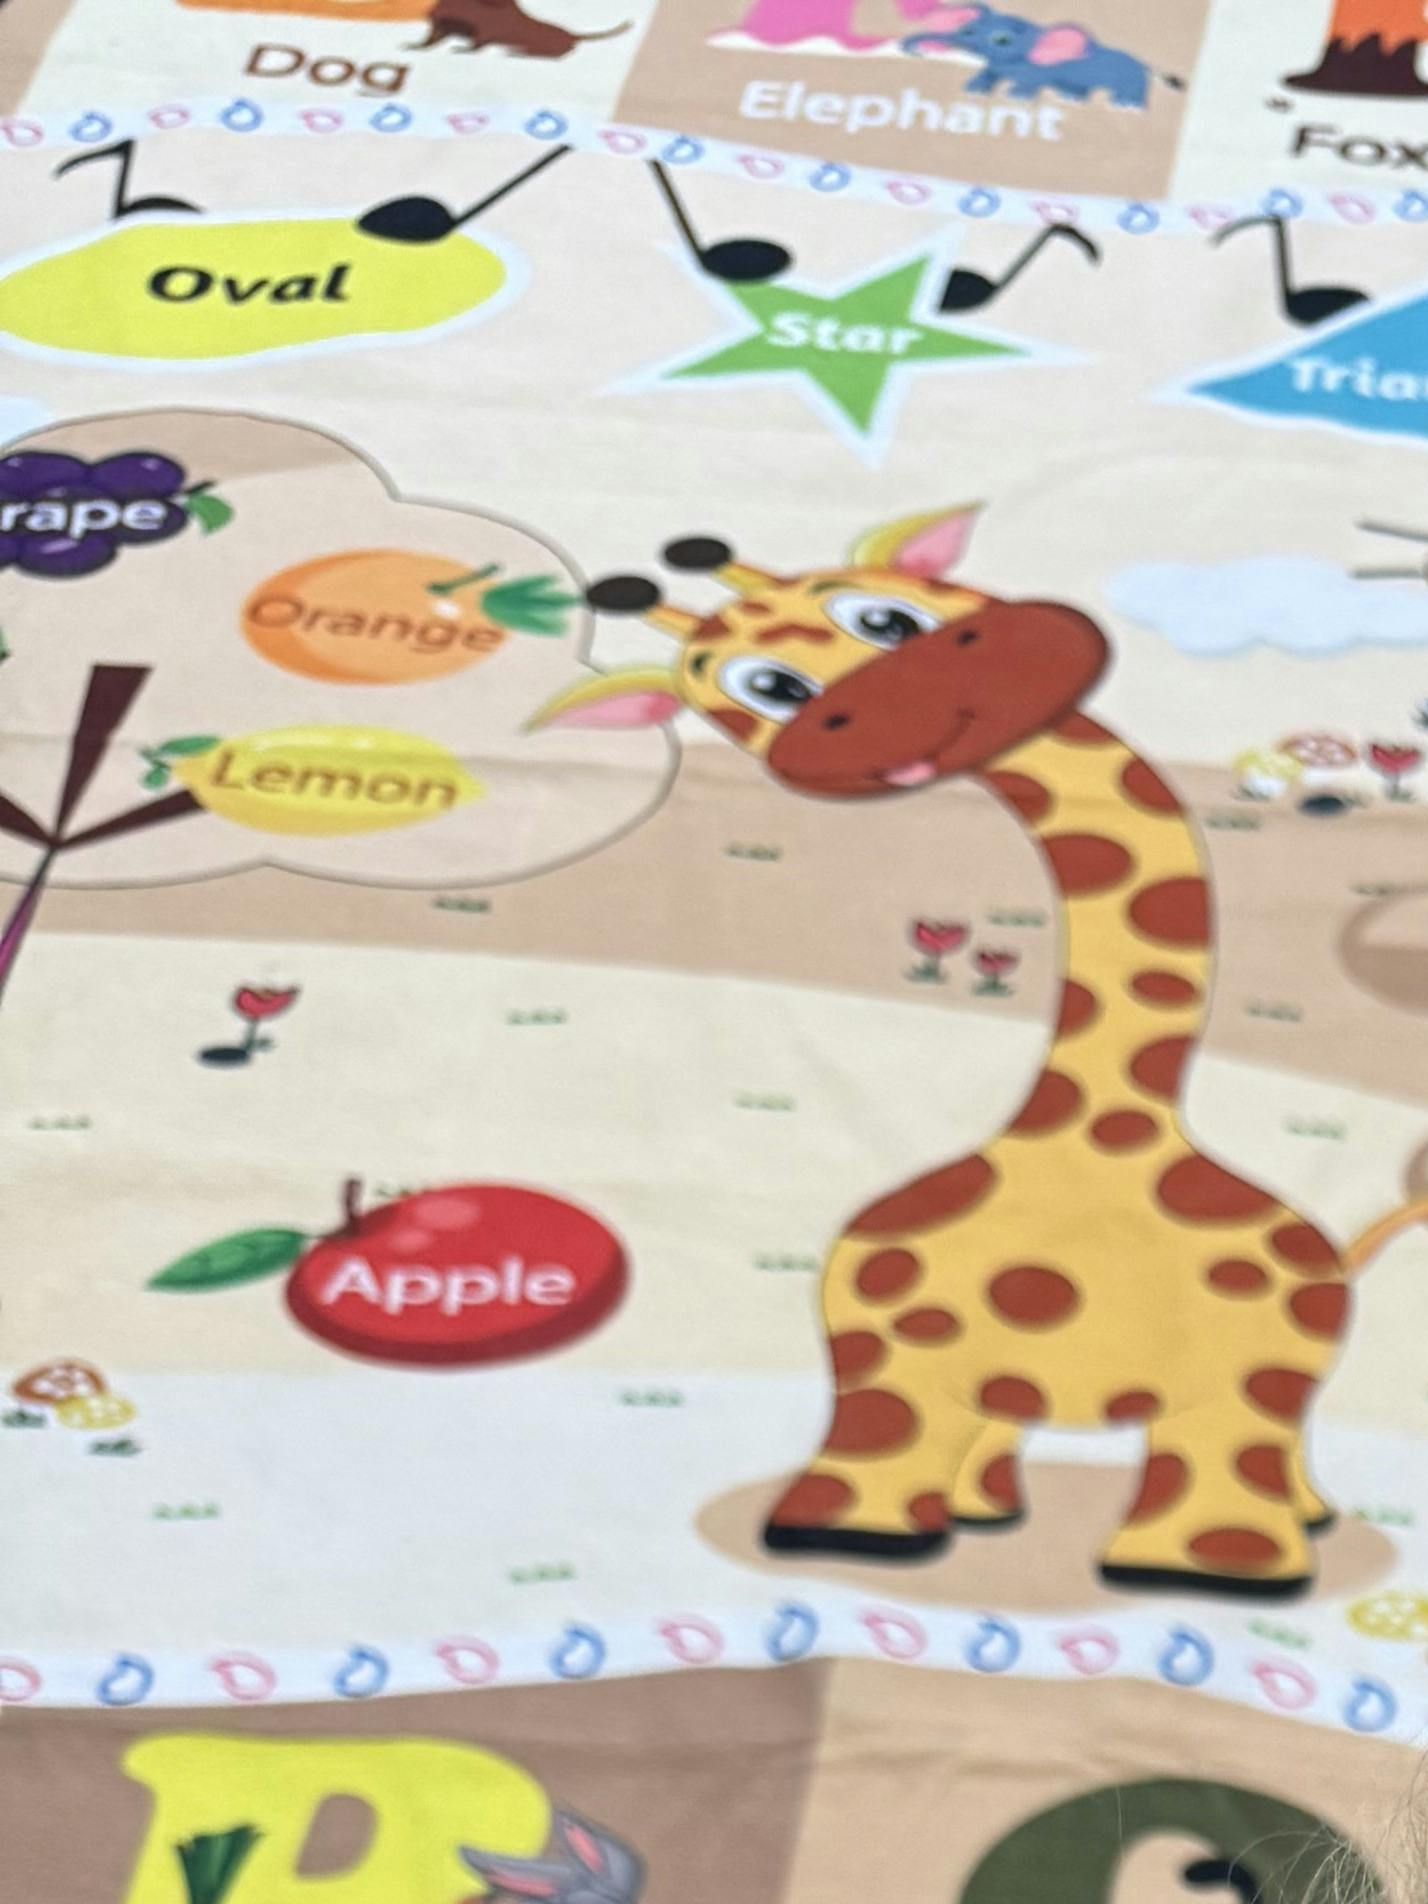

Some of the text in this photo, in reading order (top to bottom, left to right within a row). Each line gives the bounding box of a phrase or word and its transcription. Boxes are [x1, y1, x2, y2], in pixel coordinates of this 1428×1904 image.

[244, 44, 410, 97] Dog
[739, 80, 1065, 143] Elephant
[148, 264, 352, 304] Oval
[763, 313, 922, 357] Star
[0, 502, 168, 539] rape
[247, 598, 506, 658] Orange
[209, 751, 459, 811] Lemon
[320, 1255, 577, 1315] Apple
